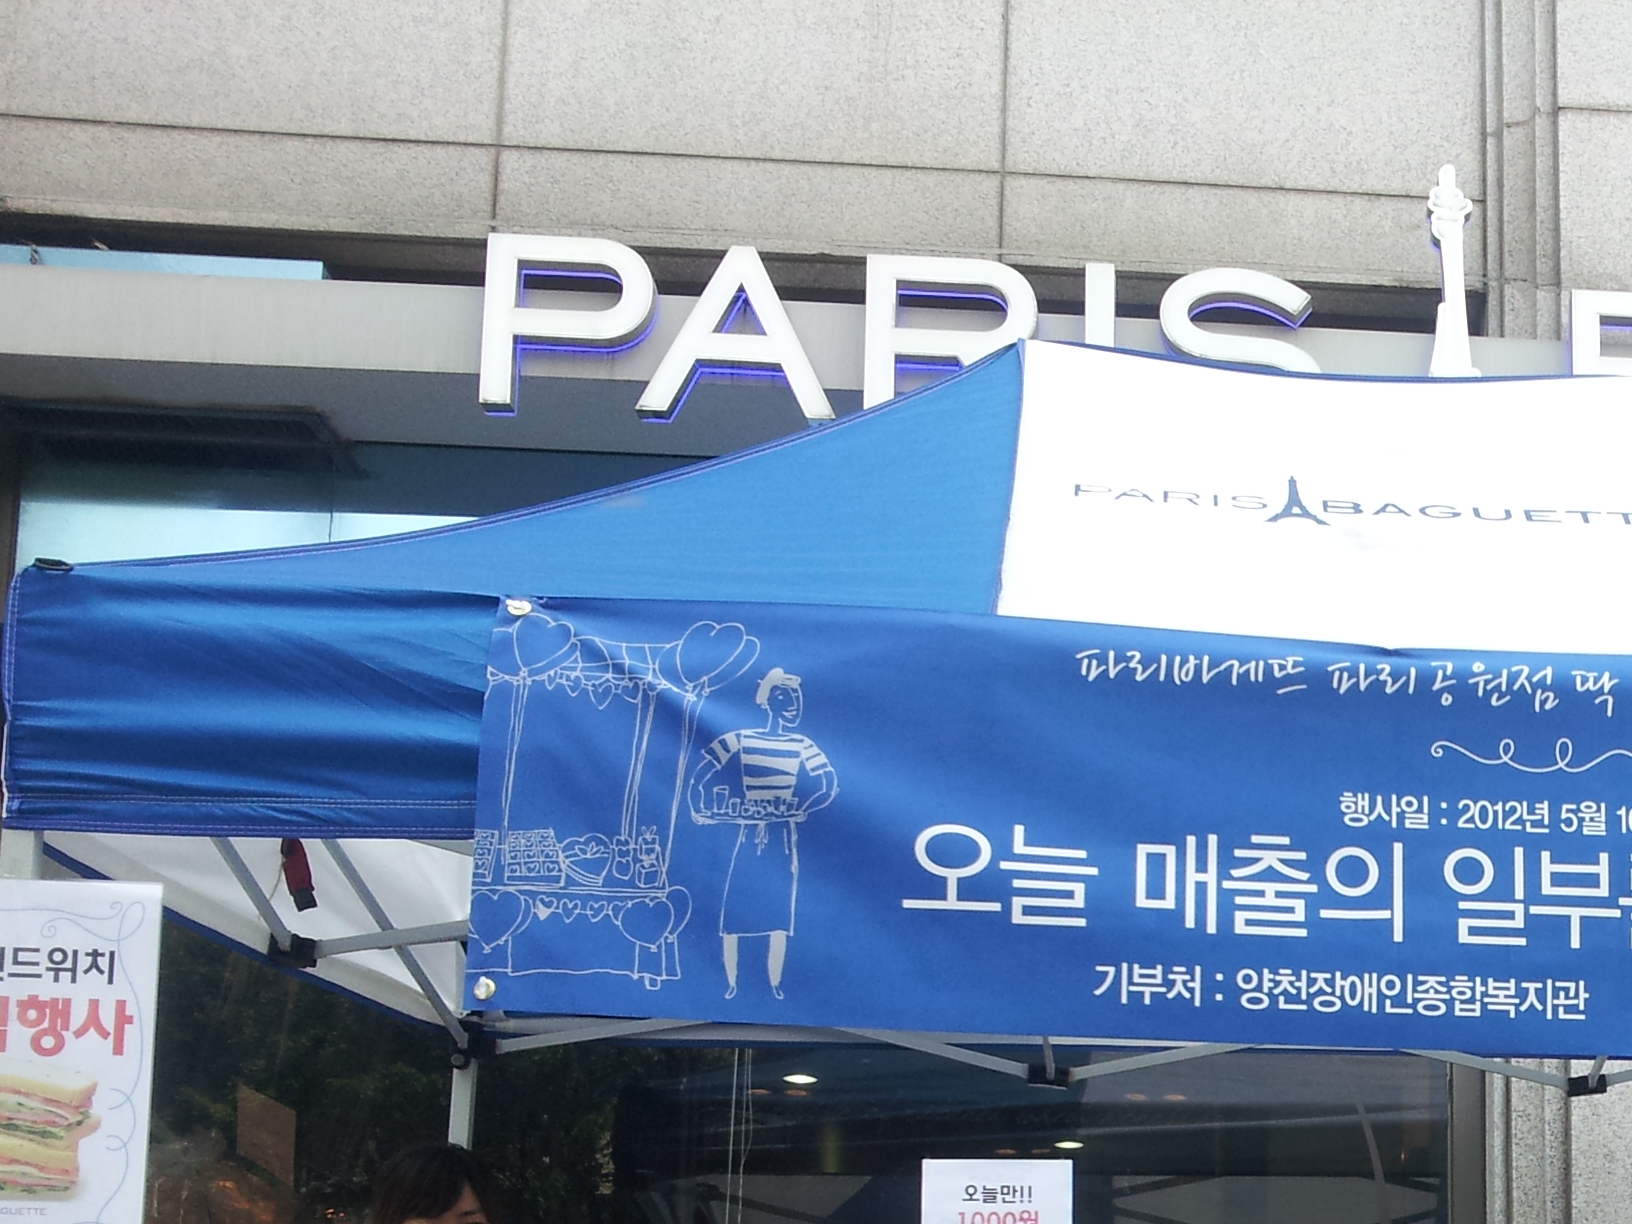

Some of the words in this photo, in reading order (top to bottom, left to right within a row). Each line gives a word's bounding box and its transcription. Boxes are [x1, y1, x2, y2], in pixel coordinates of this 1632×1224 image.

[479, 232, 1322, 424] PARIS
[1074, 482, 1268, 512] PARIS
[1075, 648, 1308, 696] 파리바게뜨
[1571, 668, 1618, 718] 딱
[1340, 791, 1431, 830] 행사일
[1457, 799, 1551, 834] 2012년
[1560, 802, 1607, 837] 5월
[902, 823, 1100, 929] 오늘
[1135, 831, 1405, 944] 매출의
[1092, 963, 1203, 1007] 기부처
[1236, 966, 1590, 1022] 양천장애인종합복지관
[961, 1184, 1033, 1205] 오늘만!!
